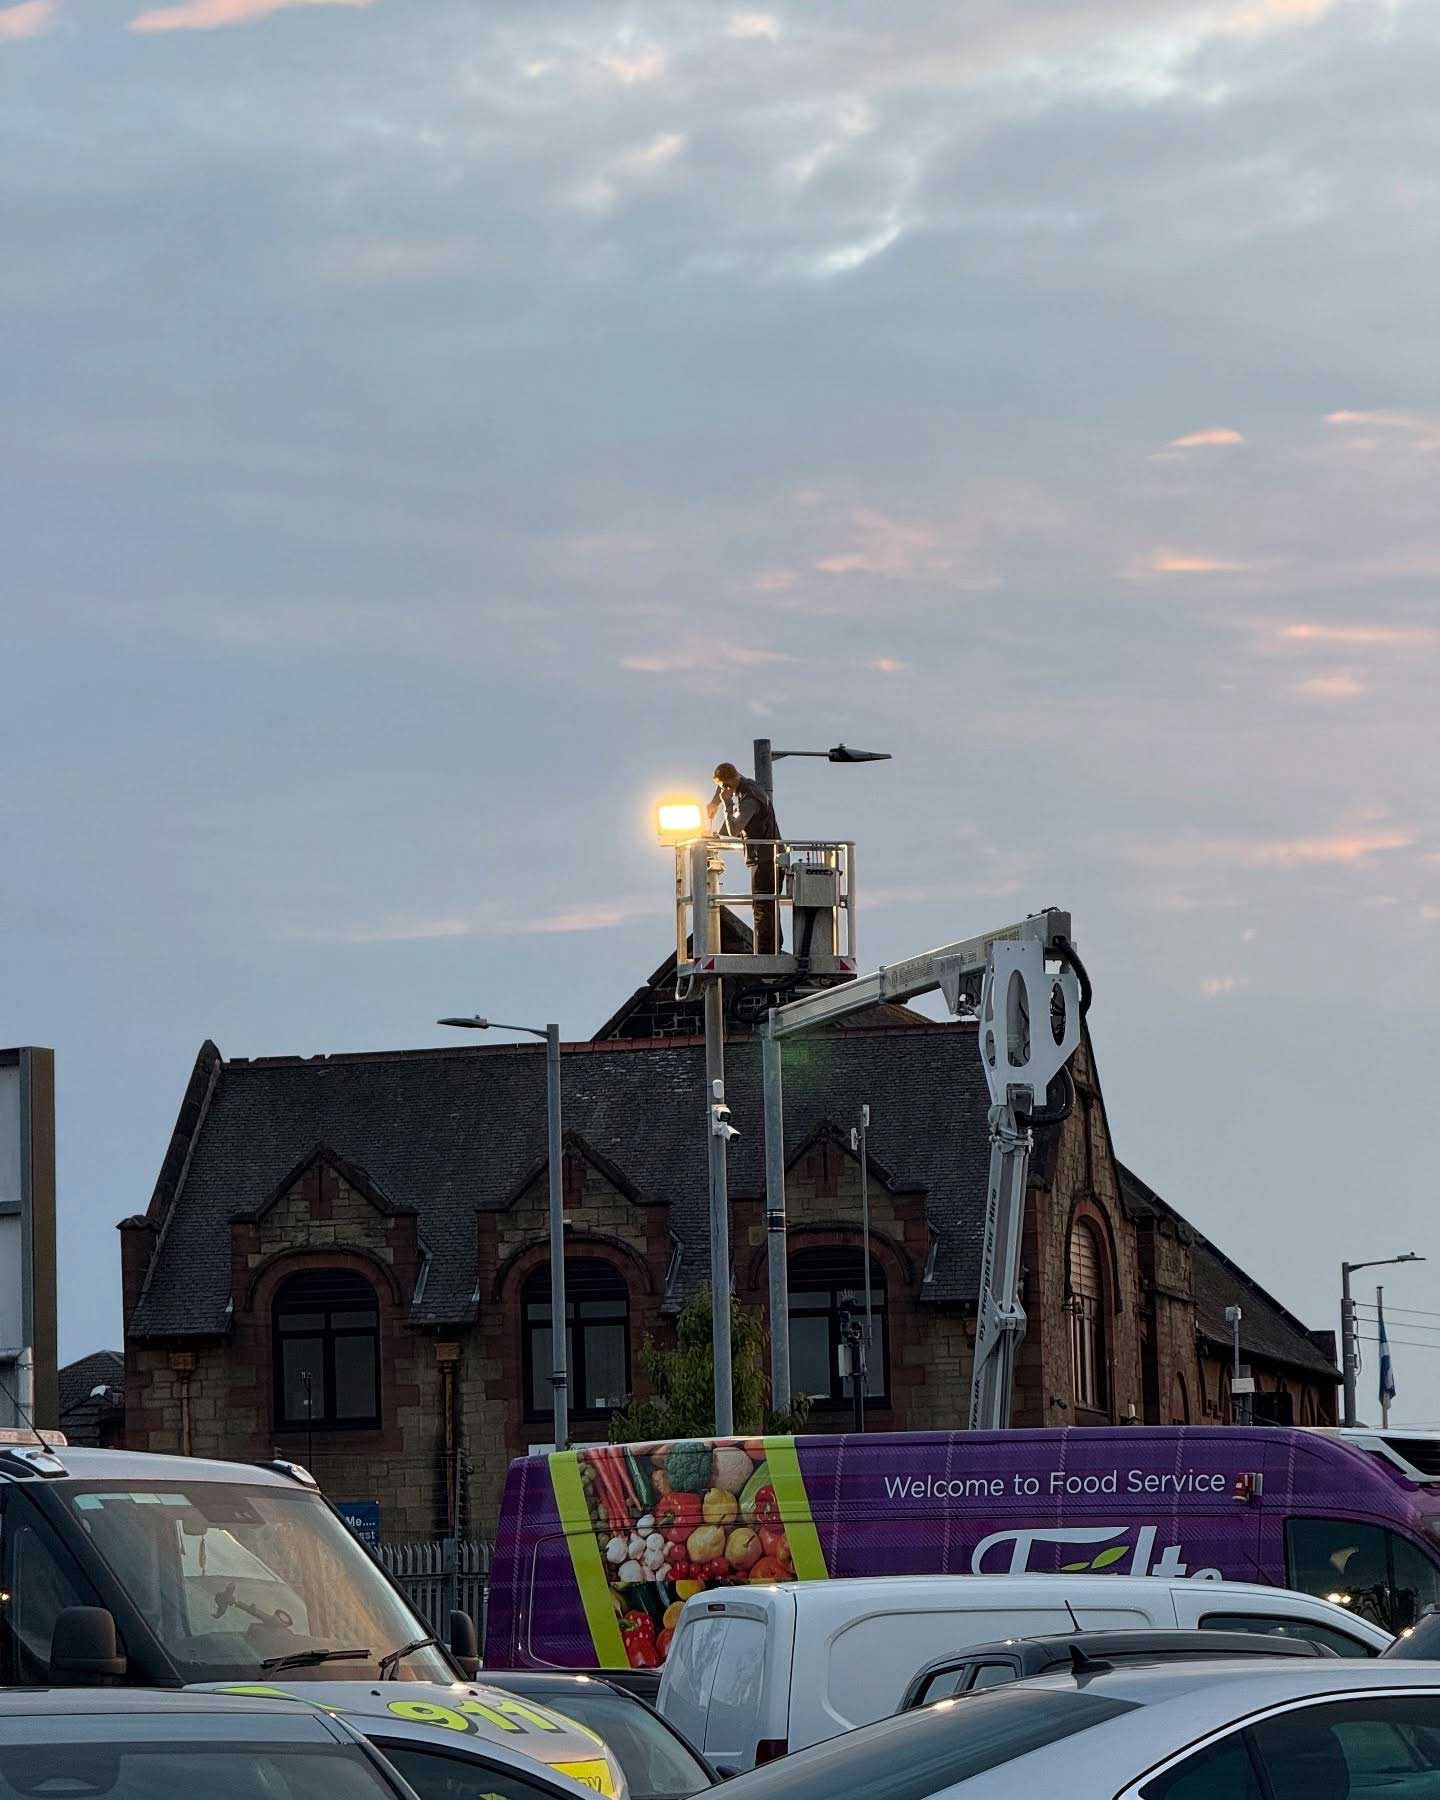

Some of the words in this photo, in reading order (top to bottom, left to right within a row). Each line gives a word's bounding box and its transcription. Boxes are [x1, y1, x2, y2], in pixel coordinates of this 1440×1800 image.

[981, 1259, 993, 1316] Height
[989, 1188, 998, 1224] Hire
[884, 1474, 1005, 1499] Welcome
[1014, 1474, 1040, 1496] to
[1049, 1469, 1117, 1494] Food
[1127, 1469, 1226, 1493] Service
[387, 1699, 567, 1735] 911
